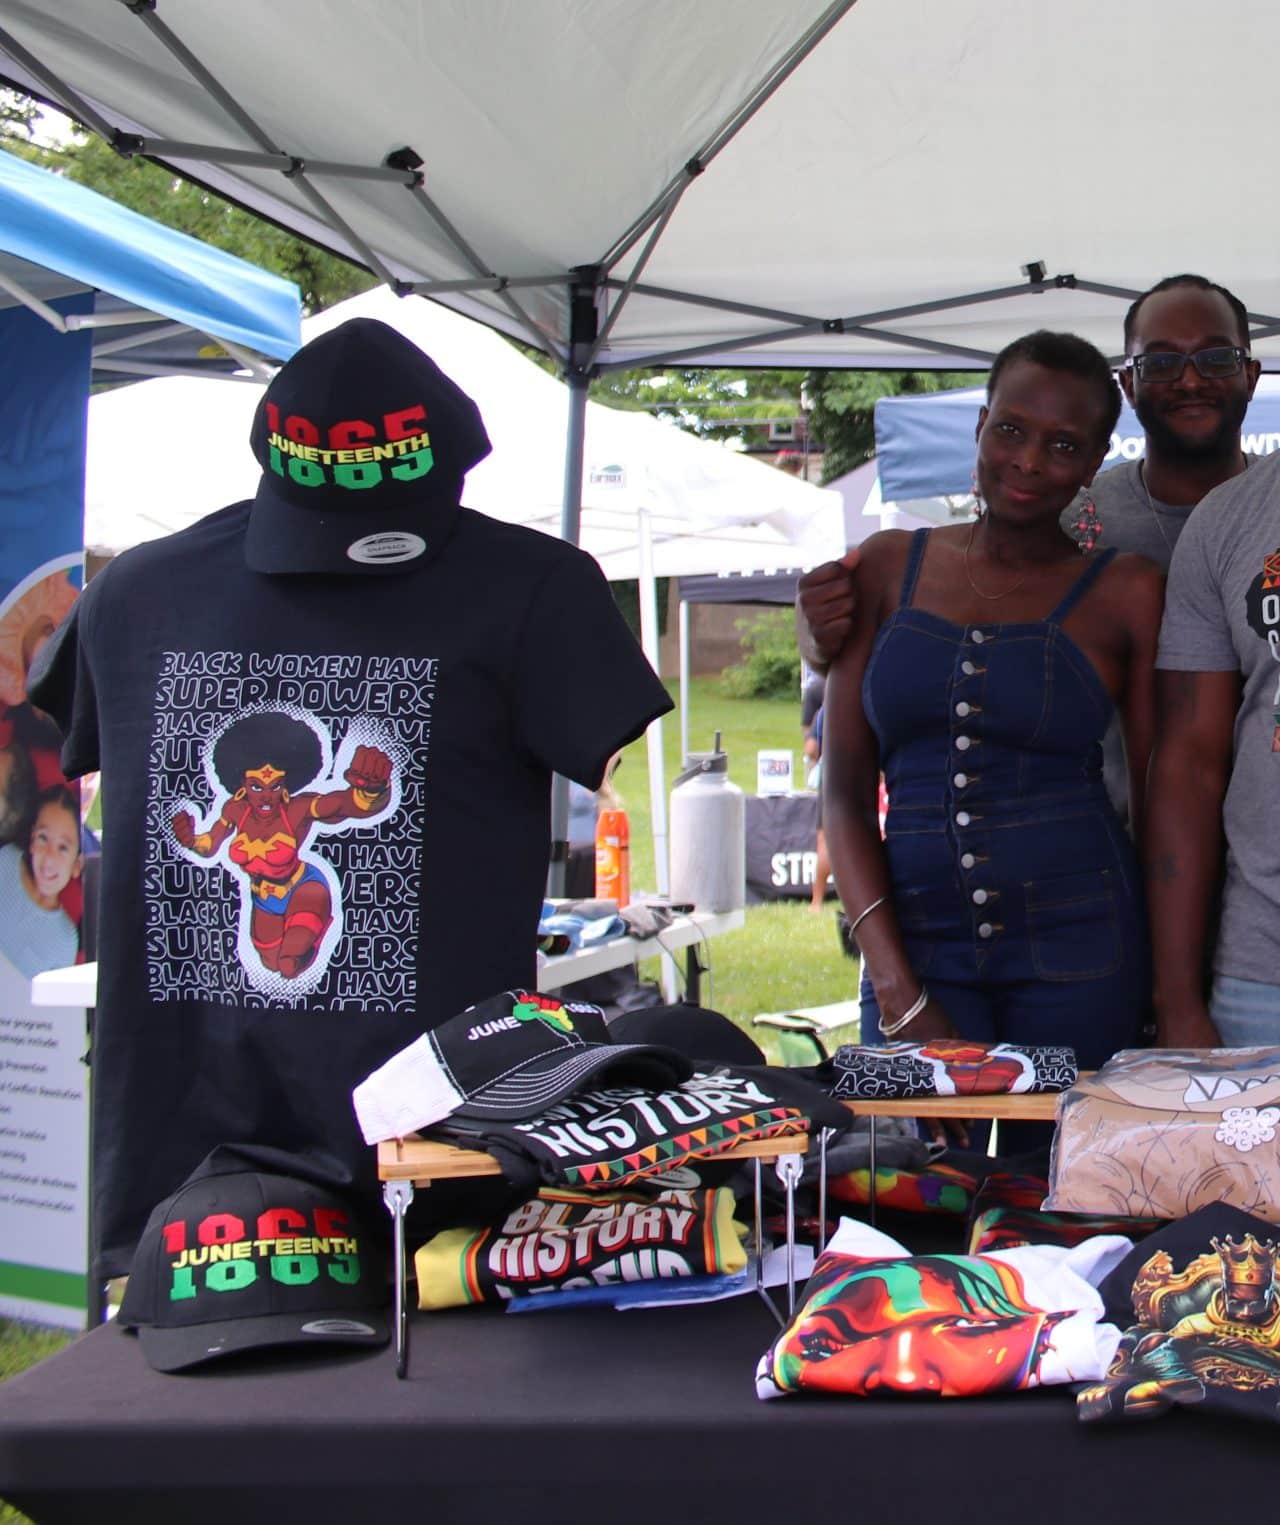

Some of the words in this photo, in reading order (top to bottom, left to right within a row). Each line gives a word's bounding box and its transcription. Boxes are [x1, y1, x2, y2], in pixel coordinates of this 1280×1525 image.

[267, 432, 431, 465] JUNETEENTH
[158, 652, 243, 677] BLACK
[249, 653, 361, 679] WOMEN
[366, 656, 440, 682] HAVE
[154, 677, 269, 710] SUPER
[278, 680, 439, 717] POWERS
[348, 844, 424, 870] HAVE
[146, 900, 219, 926] BLACK
[344, 908, 422, 934] HAVE
[149, 961, 219, 988] BLACK
[337, 971, 417, 998] HAVE
[467, 1016, 522, 1041] JUNE
[526, 1081, 776, 1158] HISTORY
[171, 1237, 358, 1268] JUNETEENTH
[488, 1203, 697, 1281] HISTORY
